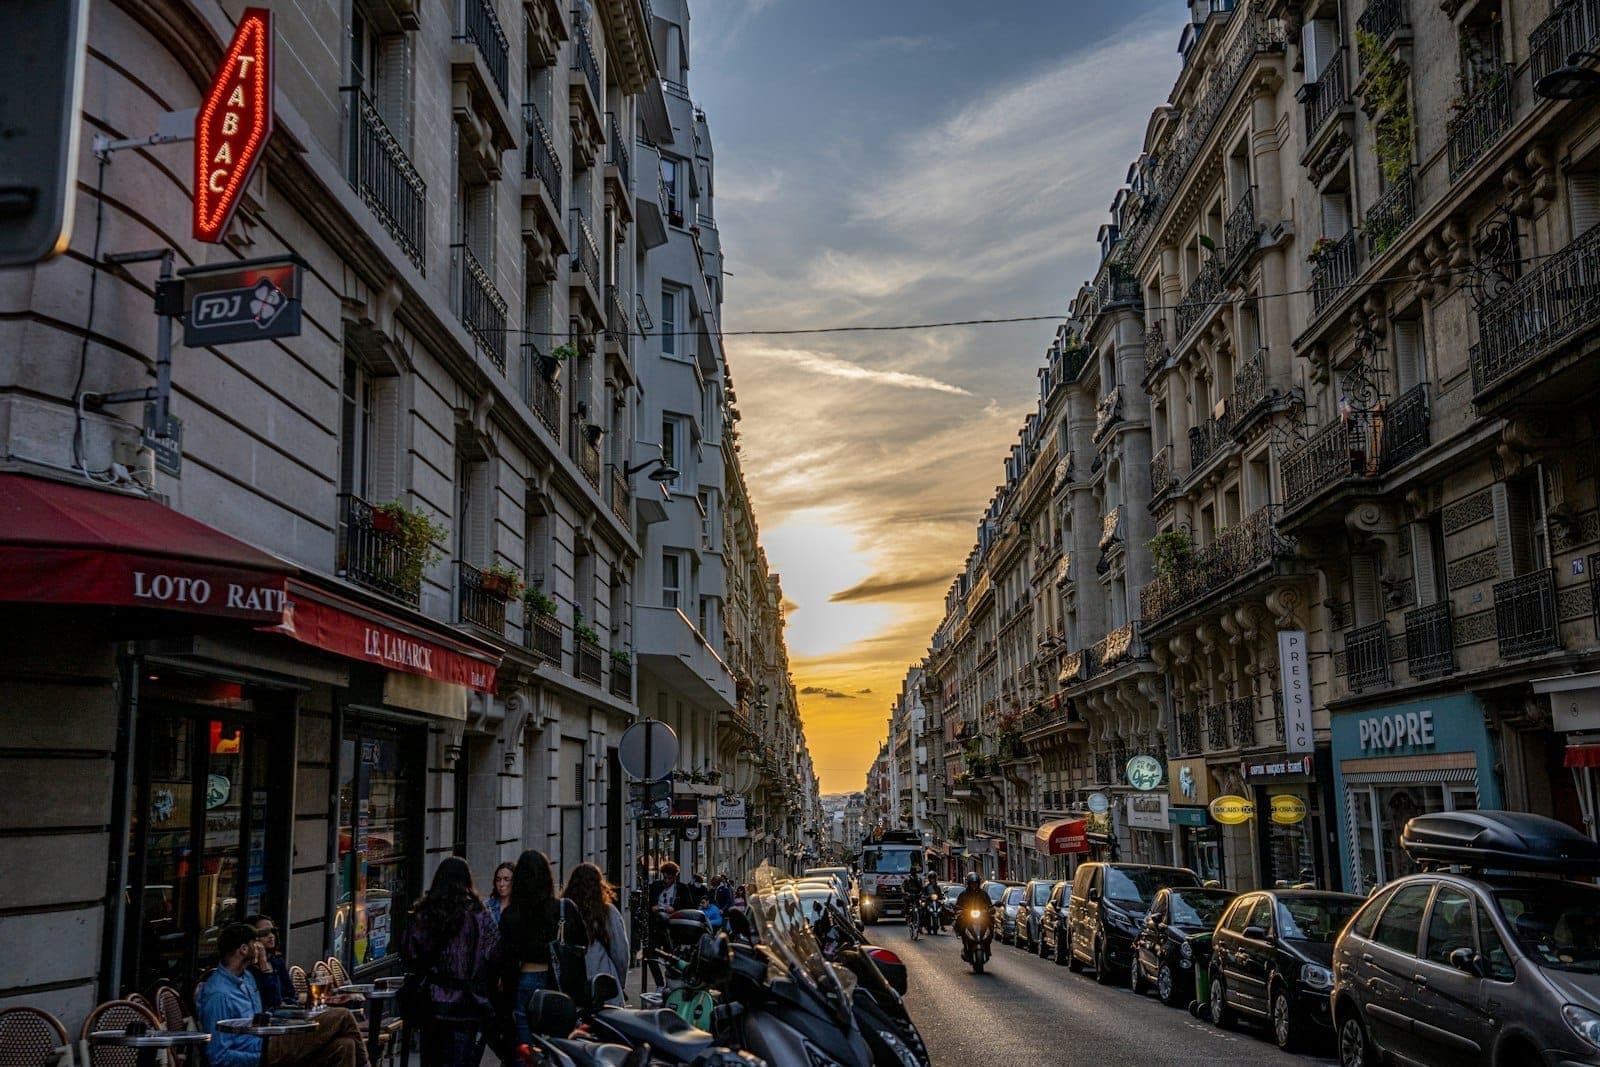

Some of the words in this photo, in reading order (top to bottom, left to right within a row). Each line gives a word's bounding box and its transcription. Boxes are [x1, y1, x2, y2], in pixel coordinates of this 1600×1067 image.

[209, 55, 255, 194] TABAC
[198, 295, 242, 321] FDJ
[132, 571, 211, 604] LOTO
[364, 628, 381, 657] LE
[383, 633, 433, 673] LAMARCK
[1289, 637, 1306, 747] PRESSING
[1359, 710, 1435, 750] PROPRE
